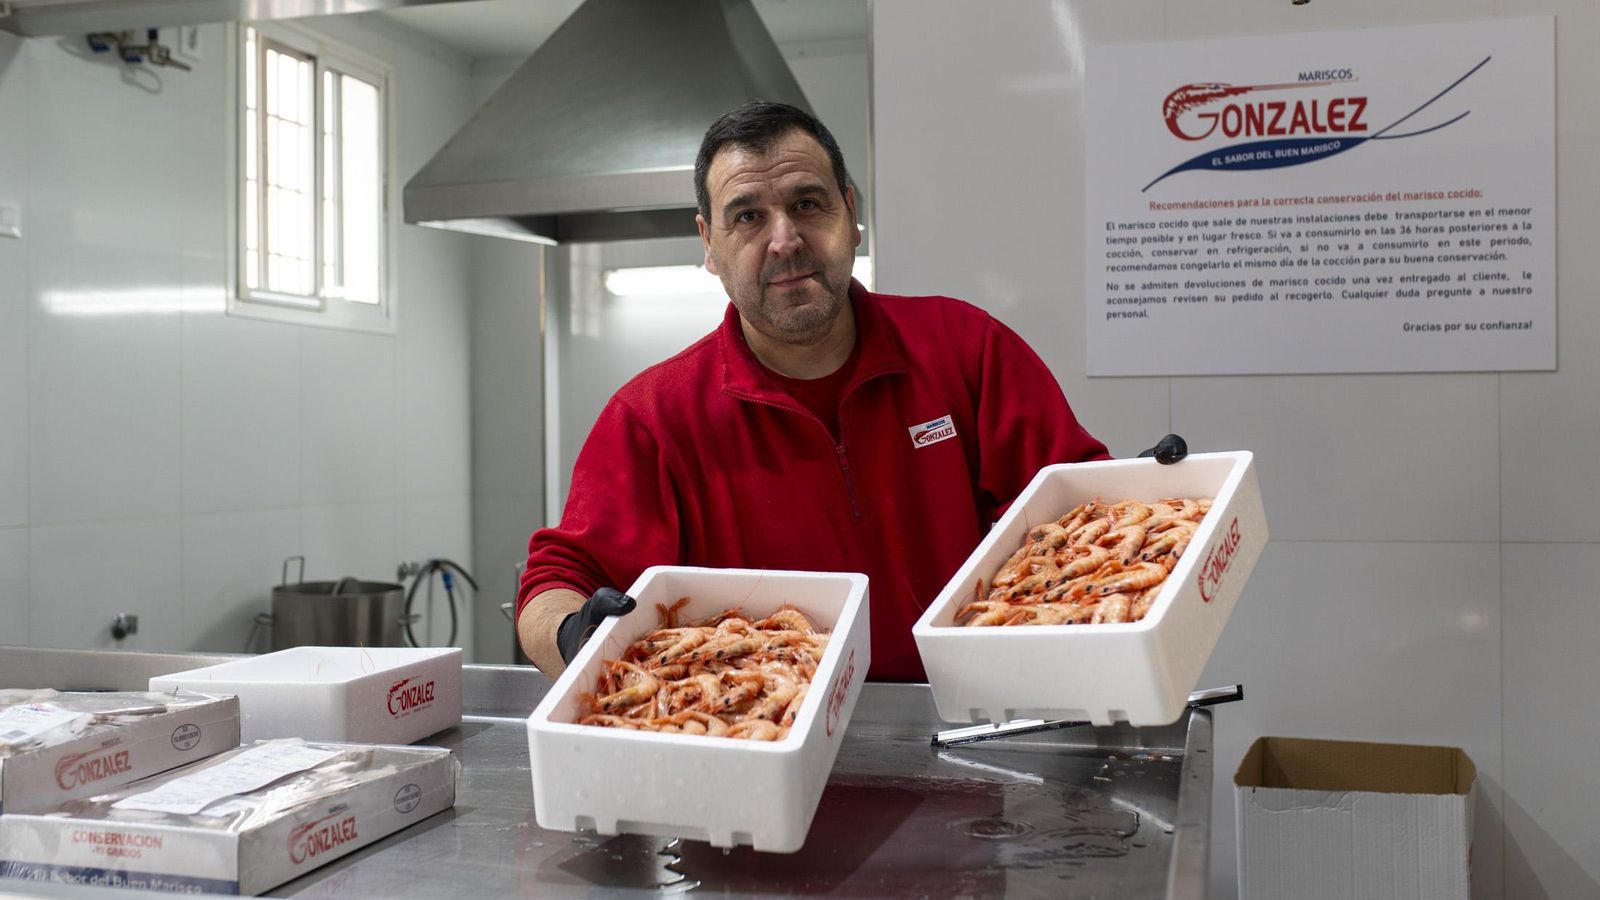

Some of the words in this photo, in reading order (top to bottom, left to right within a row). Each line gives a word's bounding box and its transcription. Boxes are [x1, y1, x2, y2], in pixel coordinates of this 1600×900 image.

[1298, 68, 1353, 82] MARISCOS
[1163, 82, 1368, 141] GONZALEZ
[1212, 157, 1223, 166] EL
[1225, 151, 1254, 165] SABOR
[1256, 149, 1274, 160] DEL
[1275, 146, 1299, 159] BUEN
[1301, 140, 1341, 156] MARISCO
[1149, 200, 1235, 210] Recomendaciones
[1237, 199, 1259, 208] para
[1262, 198, 1271, 206] la
[1273, 196, 1314, 206] correcta
[1317, 192, 1383, 204] conservación
[1385, 192, 1401, 201] del
[1403, 192, 1444, 200] marisco
[1106, 222, 1115, 231] El
[1118, 222, 1156, 230] marisco
[1159, 219, 1189, 229] cocido
[1192, 220, 1209, 229] que
[1212, 218, 1232, 227] sale
[1235, 217, 1247, 226] de
[1250, 216, 1293, 225] nuestras
[1296, 214, 1361, 223] instalaciones
[1364, 212, 1388, 221] debe
[1395, 210, 1465, 221] transportarse
[1485, 208, 1495, 216] el
[1498, 208, 1532, 216] menor
[1106, 236, 1138, 246] tiempo
[1141, 234, 1174, 245] posible
[1178, 236, 1184, 244] y
[1202, 233, 1227, 243] lugar
[1231, 232, 1263, 240] fresco.
[1267, 230, 1277, 239] Si
[1305, 227, 1361, 238] consumirlo
[1364, 228, 1377, 236] en
[1381, 226, 1396, 235] las
[1400, 225, 1412, 234] 36
[1415, 225, 1445, 234] horas
[1449, 224, 1508, 234] posteriores
[1522, 222, 1532, 230] la
[1106, 248, 1143, 258] cocción,
[1152, 249, 1198, 257] conservar
[1227, 243, 1291, 256] refrigeración,
[1300, 244, 1308, 252] si
[1317, 244, 1329, 252] no
[1373, 240, 1429, 250] consumirlo
[1438, 240, 1450, 248] en
[1459, 238, 1481, 247] este
[1490, 236, 1532, 248] periodo,
[1106, 263, 1178, 272] recomendamos
[1180, 260, 1230, 271] congelarlo
[1233, 260, 1242, 268] el
[1244, 259, 1277, 268] mismo
[1279, 257, 1294, 267] día
[1296, 258, 1309, 267] de
[1311, 257, 1321, 266] la
[1323, 255, 1361, 266] cocción
[1363, 257, 1386, 266] para
[1388, 256, 1401, 264] su
[1404, 254, 1434, 263] buena
[1437, 251, 1508, 262] conservación.
[1106, 282, 1119, 291] No
[1141, 282, 1179, 290] admiten
[1184, 280, 1246, 289] devoluciones
[1252, 278, 1263, 287] de
[1269, 278, 1309, 286] marisco
[1314, 276, 1346, 285] cocido
[1400, 273, 1451, 284] entregado
[1457, 272, 1466, 281] al
[1473, 272, 1510, 281] cliente,
[1522, 271, 1532, 279] le
[1106, 296, 1167, 306] aconsejamos
[1173, 295, 1208, 303] revisen
[1232, 292, 1264, 303] pedido
[1270, 292, 1279, 301] al
[1285, 290, 1335, 302] recogerlo.
[1341, 290, 1389, 300] Cualquier
[1395, 289, 1420, 298] duda
[1426, 288, 1472, 299] pregunte
[1479, 288, 1485, 296] a
[1492, 286, 1533, 295] nuestro
[1106, 309, 1149, 320] personal.
[1403, 322, 1441, 332] Gracias
[1445, 324, 1461, 333] por
[1465, 323, 1476, 331] su
[1480, 320, 1532, 330] confianza!
[914, 428, 953, 444] GONZALEZ
[387, 680, 434, 715] GONZALEZ
[55, 750, 131, 790] GONZALEZ
[73, 830, 162, 848] CONSERVACION
[288, 816, 357, 864] GONZALEZ
